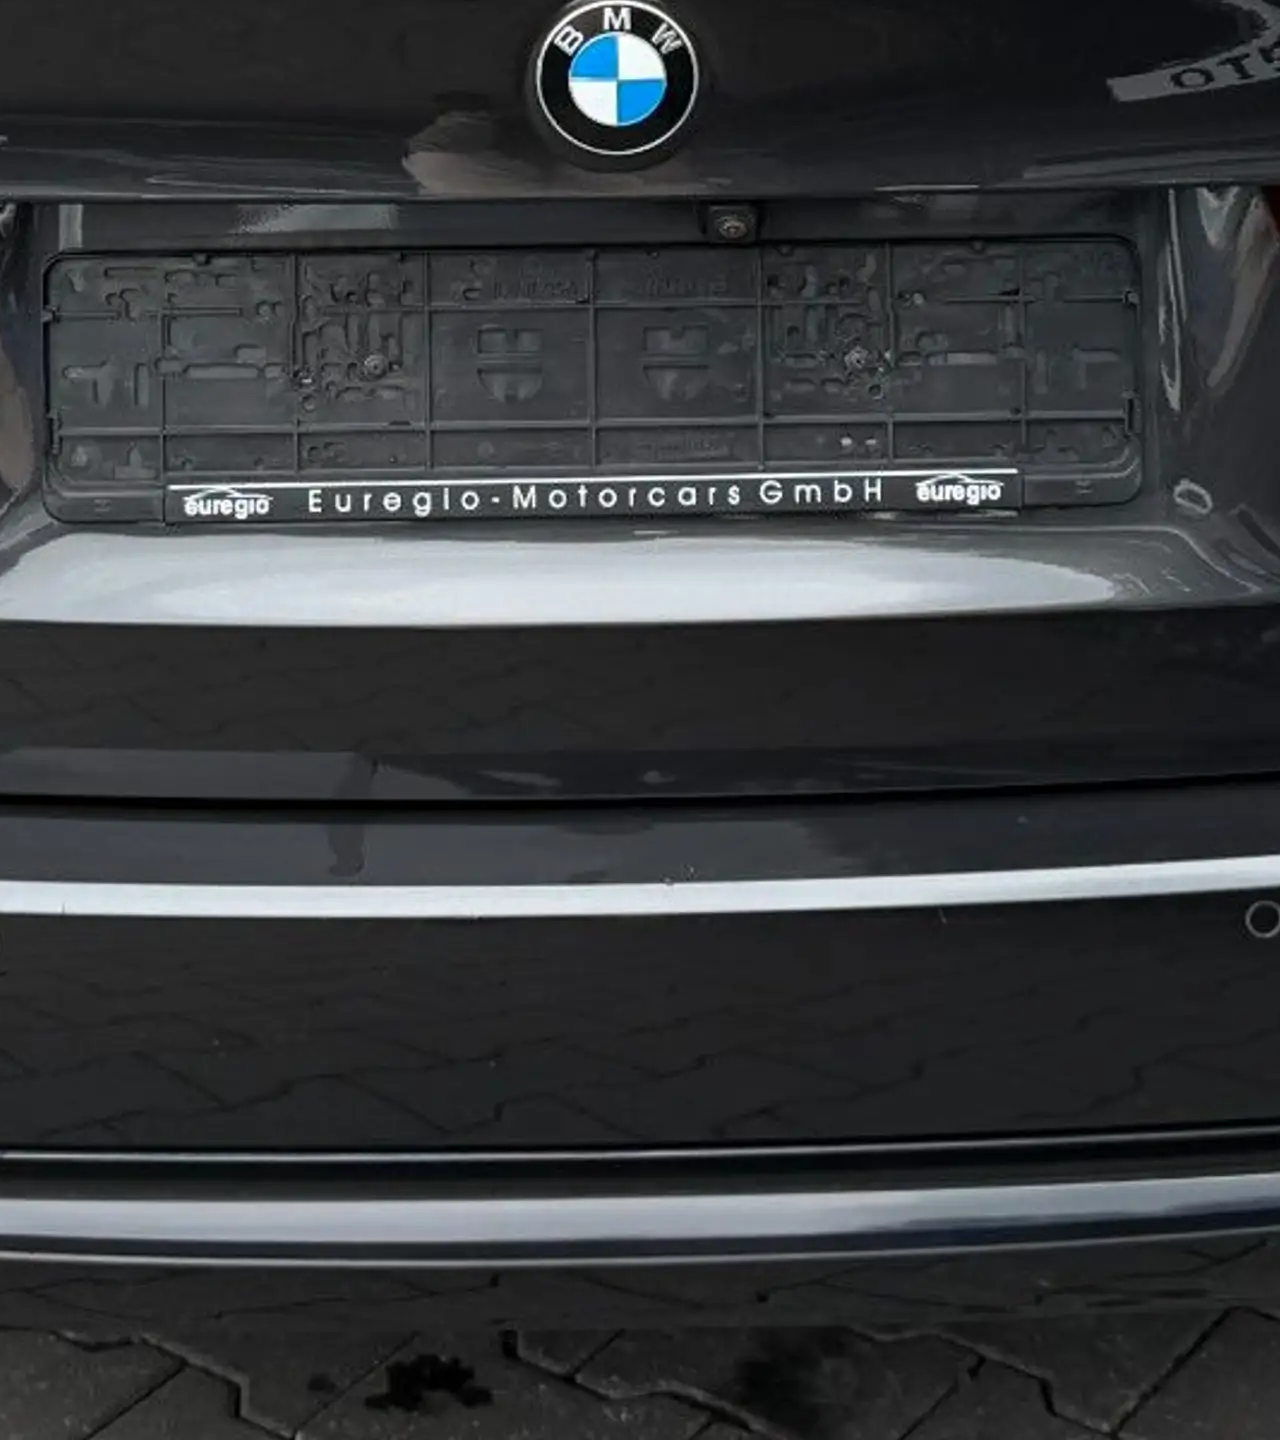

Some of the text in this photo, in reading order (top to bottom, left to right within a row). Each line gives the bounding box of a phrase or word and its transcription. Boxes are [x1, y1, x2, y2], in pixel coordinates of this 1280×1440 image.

[553, 6, 683, 57] BMW
[759, 477, 883, 505] GmbH
[916, 481, 1002, 506] euregio
[183, 492, 271, 519] euregio
